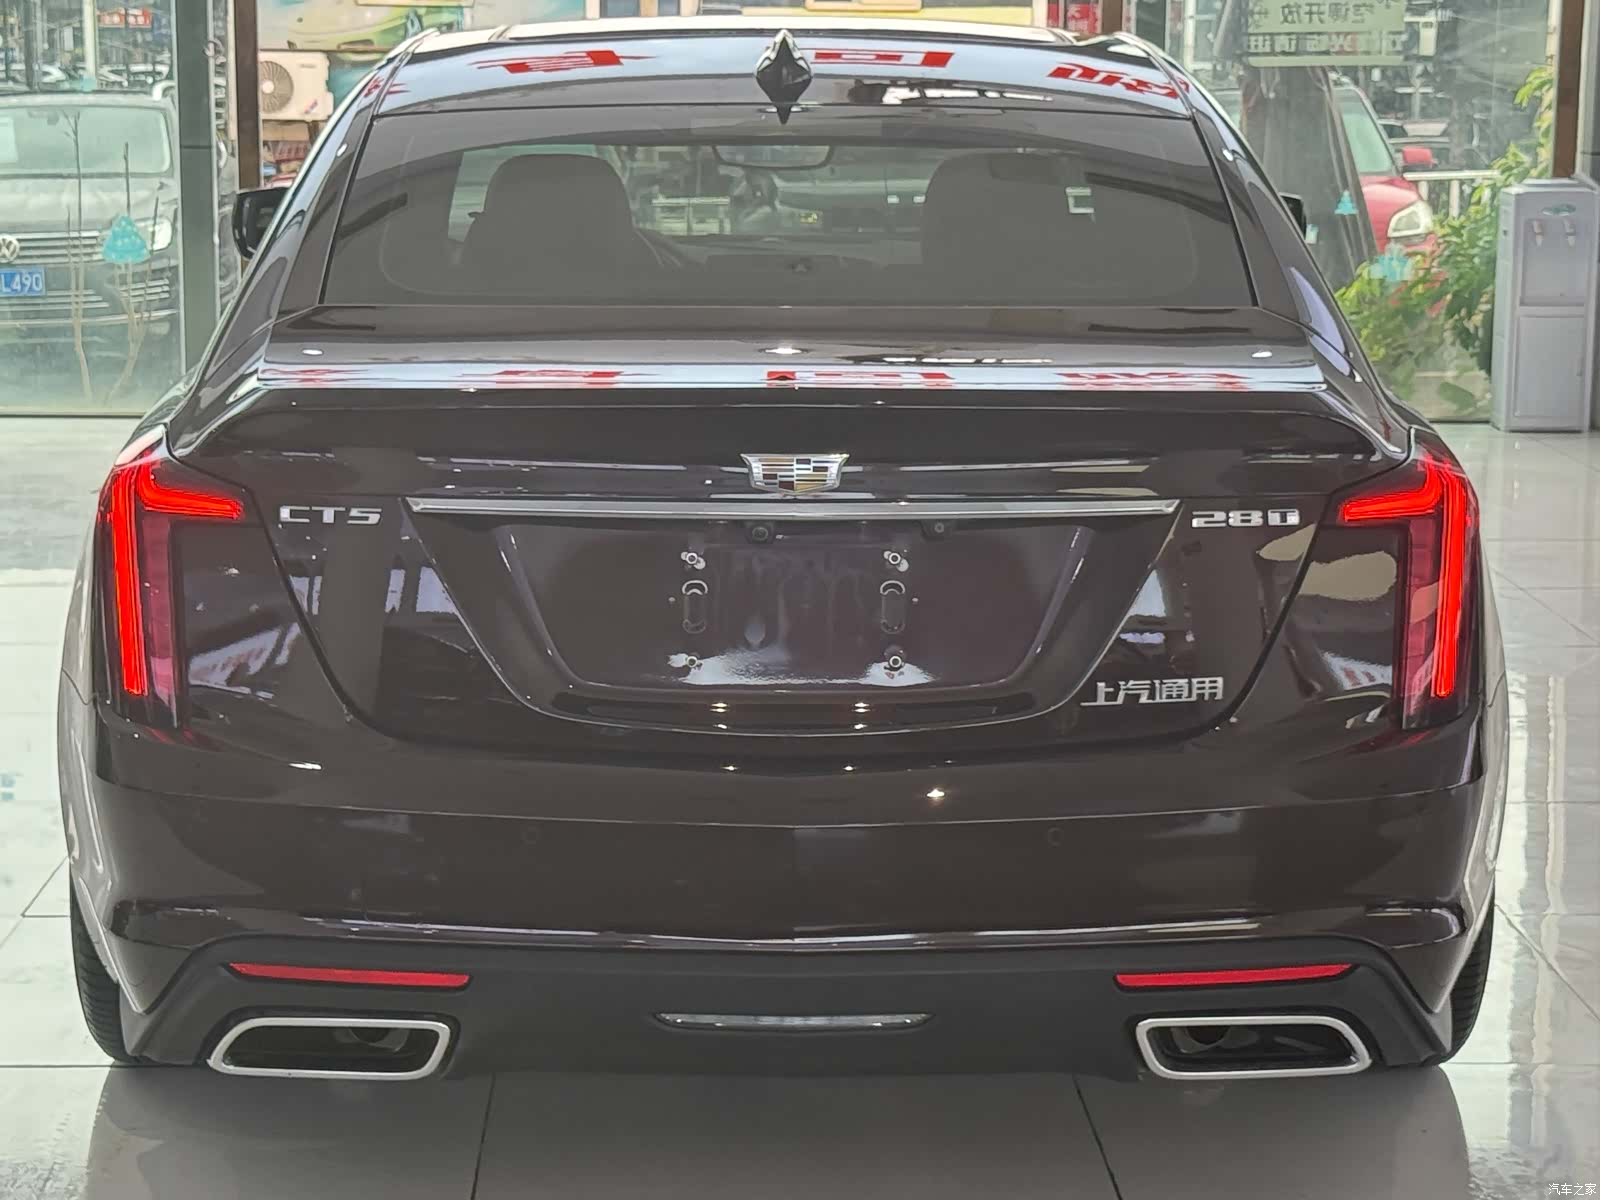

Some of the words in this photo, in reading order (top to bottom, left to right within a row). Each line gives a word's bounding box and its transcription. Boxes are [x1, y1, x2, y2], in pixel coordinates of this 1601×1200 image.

[279, 504, 383, 525] CT5
[1191, 508, 1301, 528] 28T
[1080, 676, 1224, 706] 上汽通用
